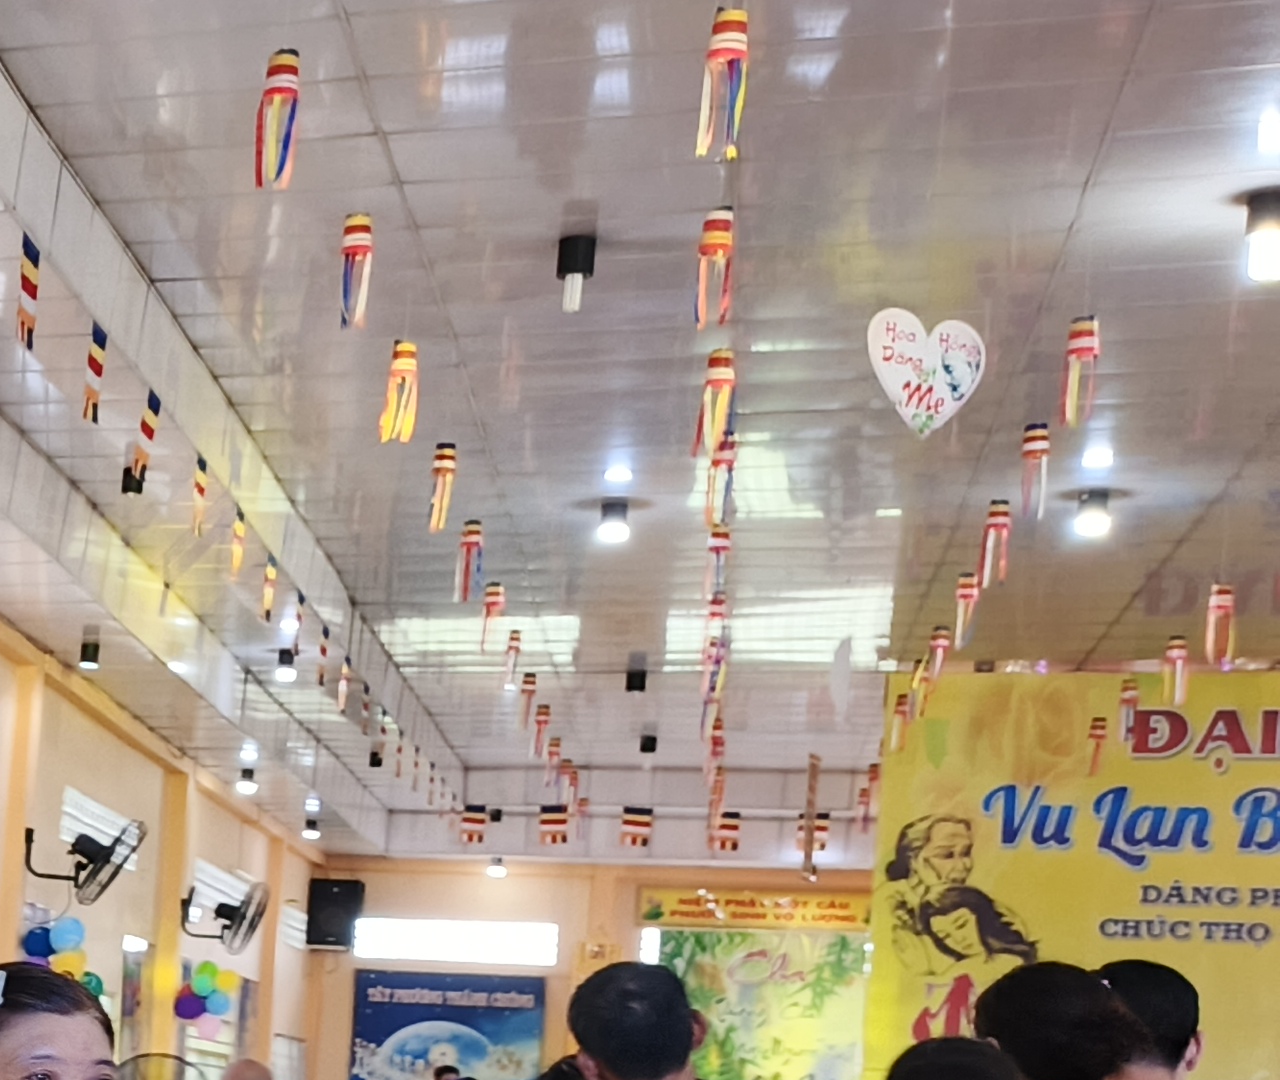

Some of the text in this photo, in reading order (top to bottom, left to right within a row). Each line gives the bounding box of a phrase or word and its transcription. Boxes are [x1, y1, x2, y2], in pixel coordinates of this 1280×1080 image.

[1129, 708, 1280, 769] ĐẠI
[983, 785, 1076, 848] Vu
[1093, 786, 1211, 868] Lan
[1099, 913, 1271, 948] CHÚC THỌ
